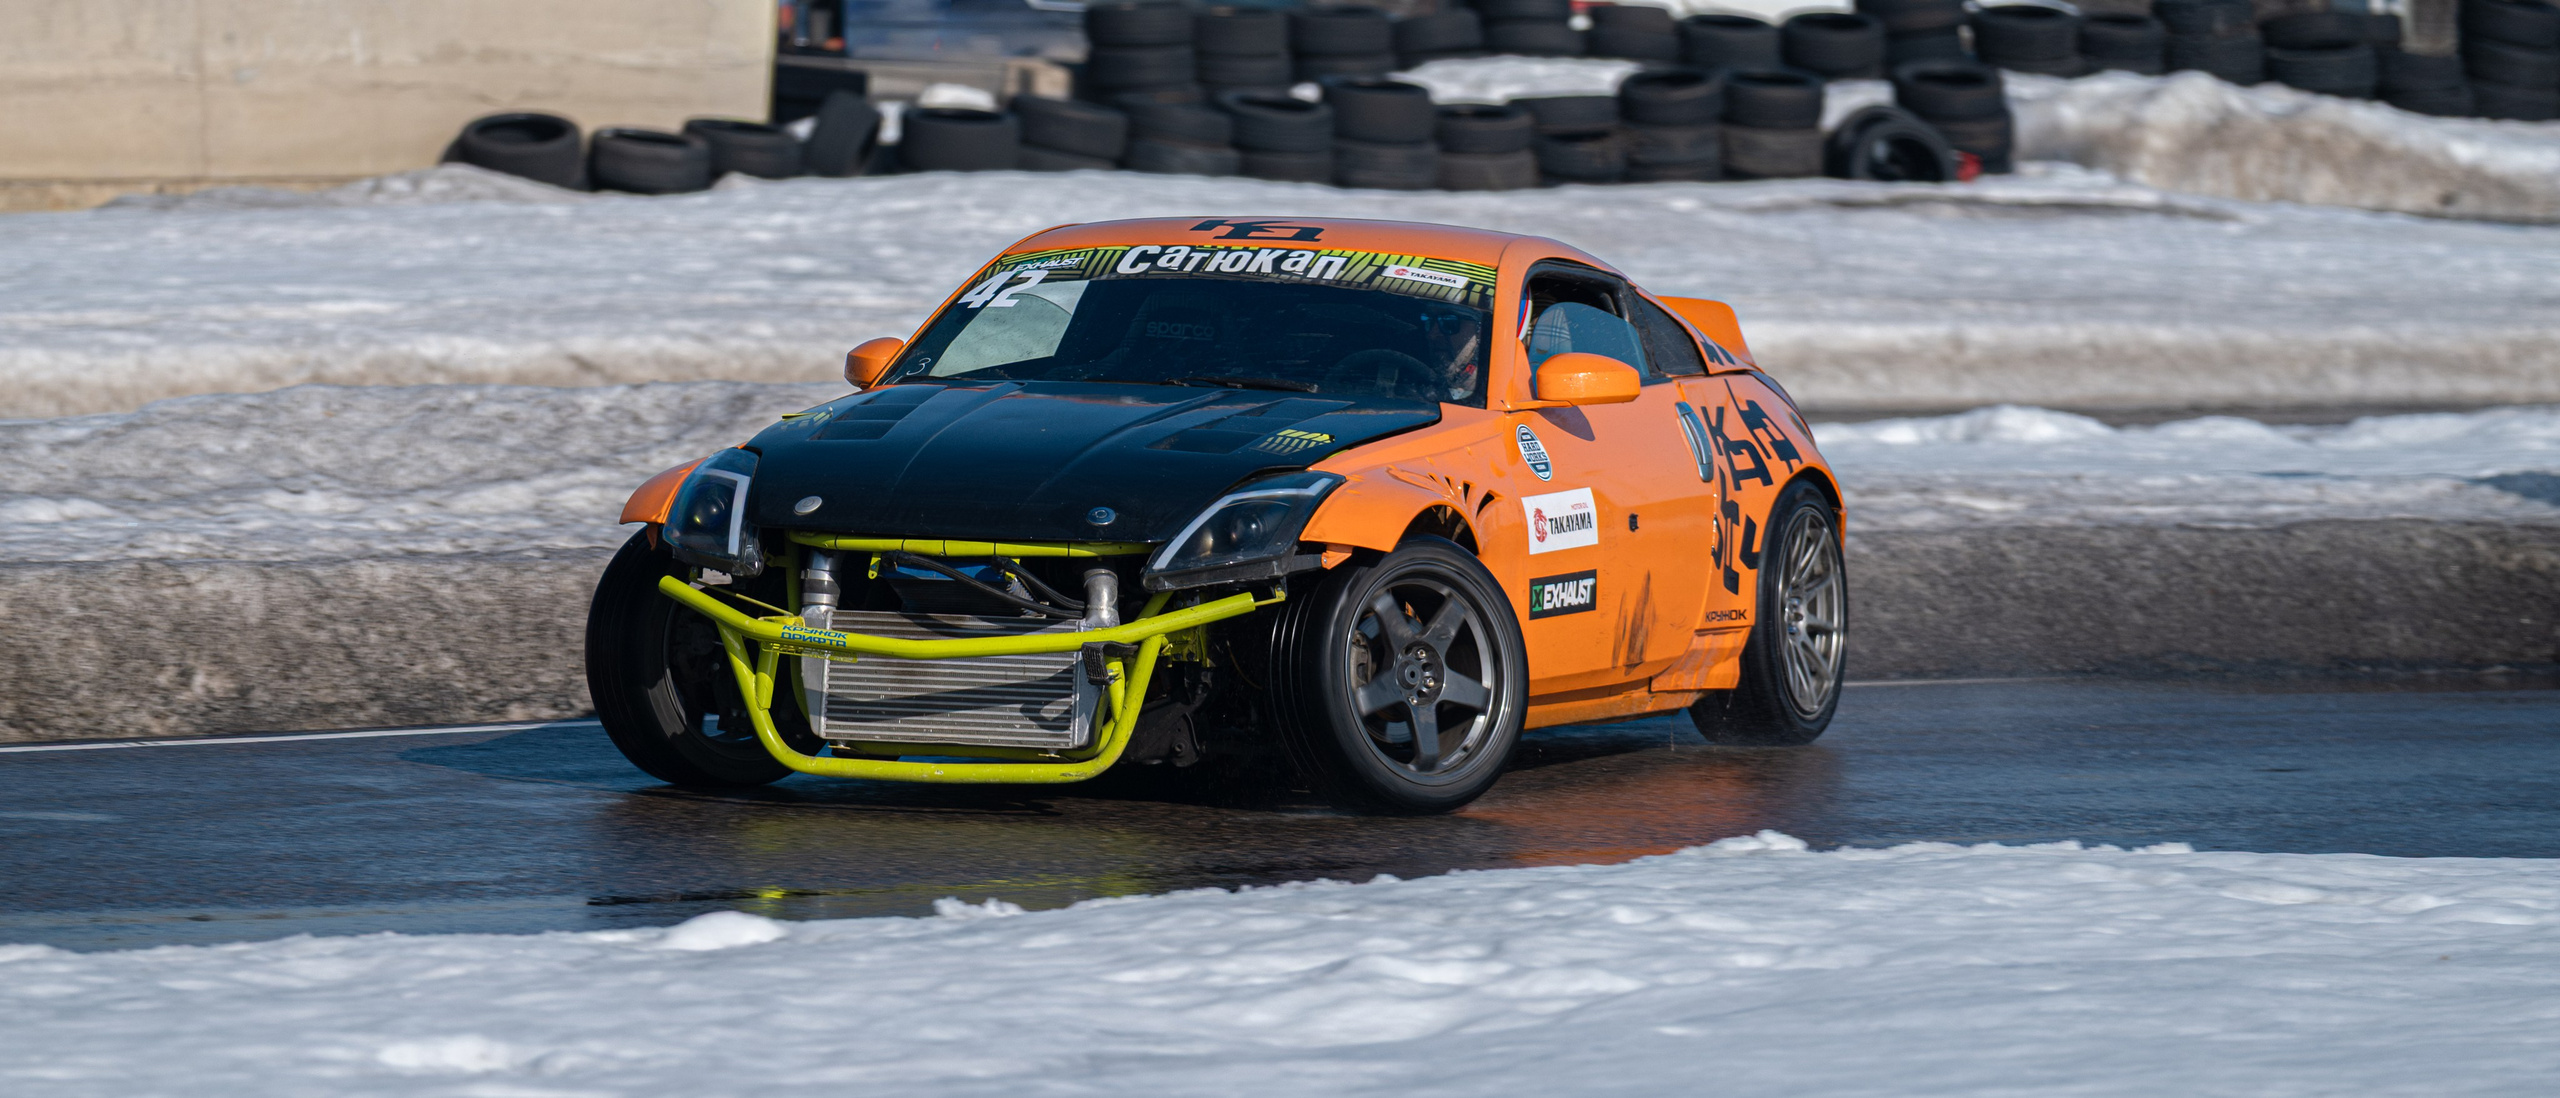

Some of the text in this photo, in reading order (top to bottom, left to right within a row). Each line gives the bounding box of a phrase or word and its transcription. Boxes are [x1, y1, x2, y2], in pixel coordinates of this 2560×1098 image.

[1410, 271, 1457, 284] TAKAYAMA
[957, 269, 1049, 309] 42
[1146, 321, 1215, 338] sparco
[1548, 512, 1593, 535] TAKAYAMA
[1543, 578, 1596, 610] EXHAUST
[1705, 608, 1748, 623] КРУЖОК
[781, 632, 847, 647] ДРИФТА
[783, 625, 848, 639] КРУЖОК
